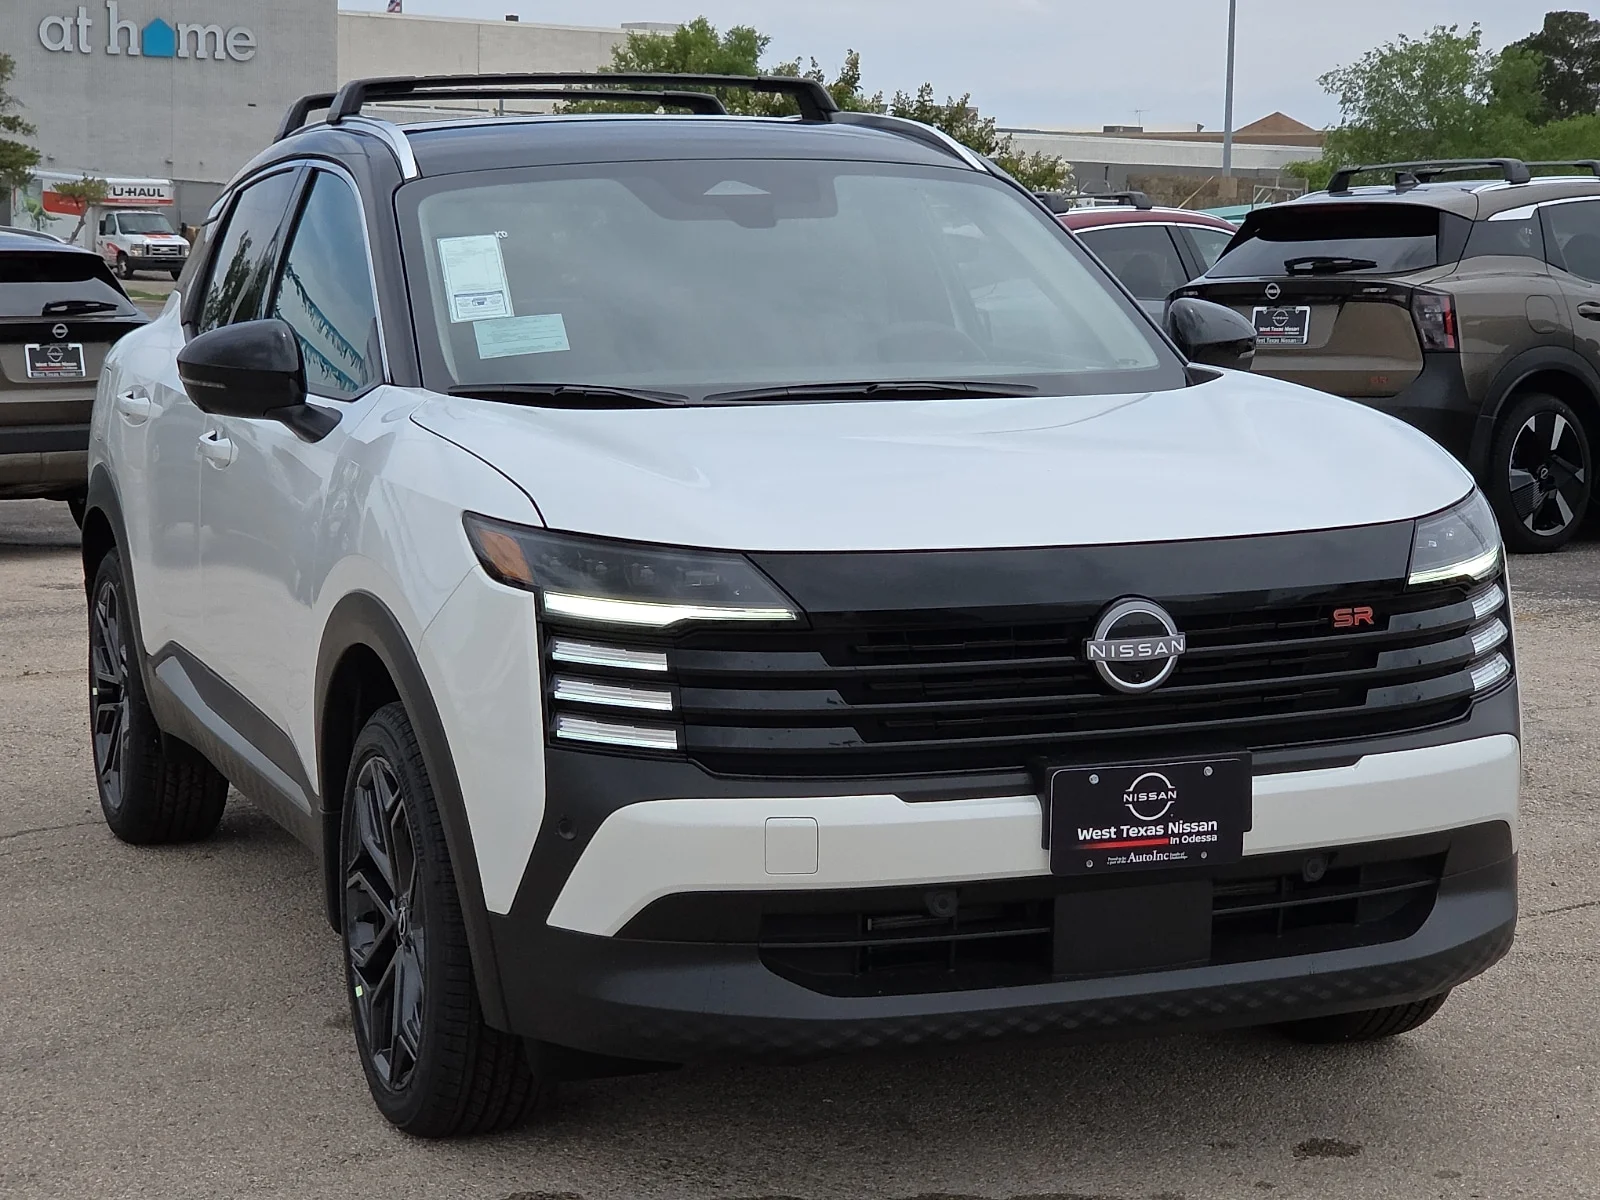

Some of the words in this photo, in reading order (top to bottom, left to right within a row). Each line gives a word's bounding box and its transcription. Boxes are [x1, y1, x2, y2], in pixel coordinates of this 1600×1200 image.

[39, 6, 92, 54] at
[1333, 606, 1375, 628] SR
[1089, 638, 1185, 659] NISSAN
[1123, 790, 1177, 803] NISSAN
[1077, 826, 1117, 841] West
[1120, 824, 1164, 838] Texas
[1168, 820, 1218, 834] Nissan
[1170, 836, 1179, 845] In
[1181, 834, 1218, 844] Odessa
[1127, 849, 1170, 863] AutoInc
